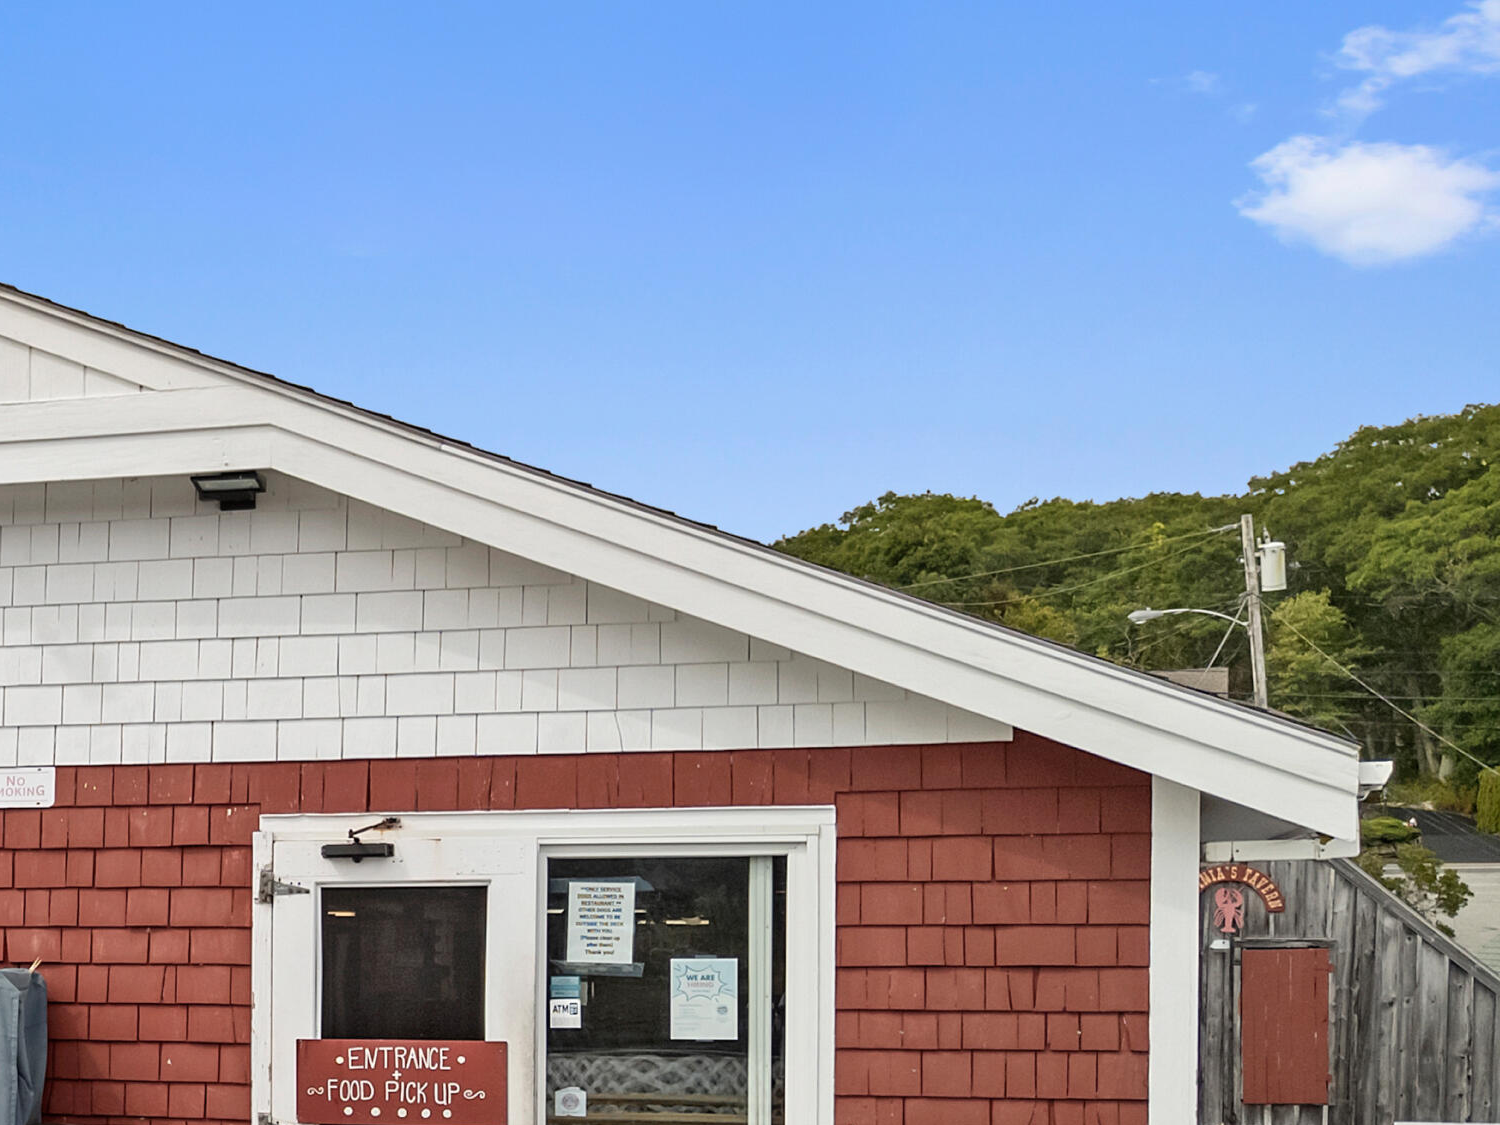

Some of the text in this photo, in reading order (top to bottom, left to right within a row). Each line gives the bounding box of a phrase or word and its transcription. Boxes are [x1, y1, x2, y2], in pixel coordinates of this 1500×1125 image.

[1243, 868, 1283, 909] TAVERN
[552, 1004, 569, 1014] ATM
[348, 1047, 451, 1070] ENTRANCE
[327, 1078, 460, 1105] FOOD PICK UP
